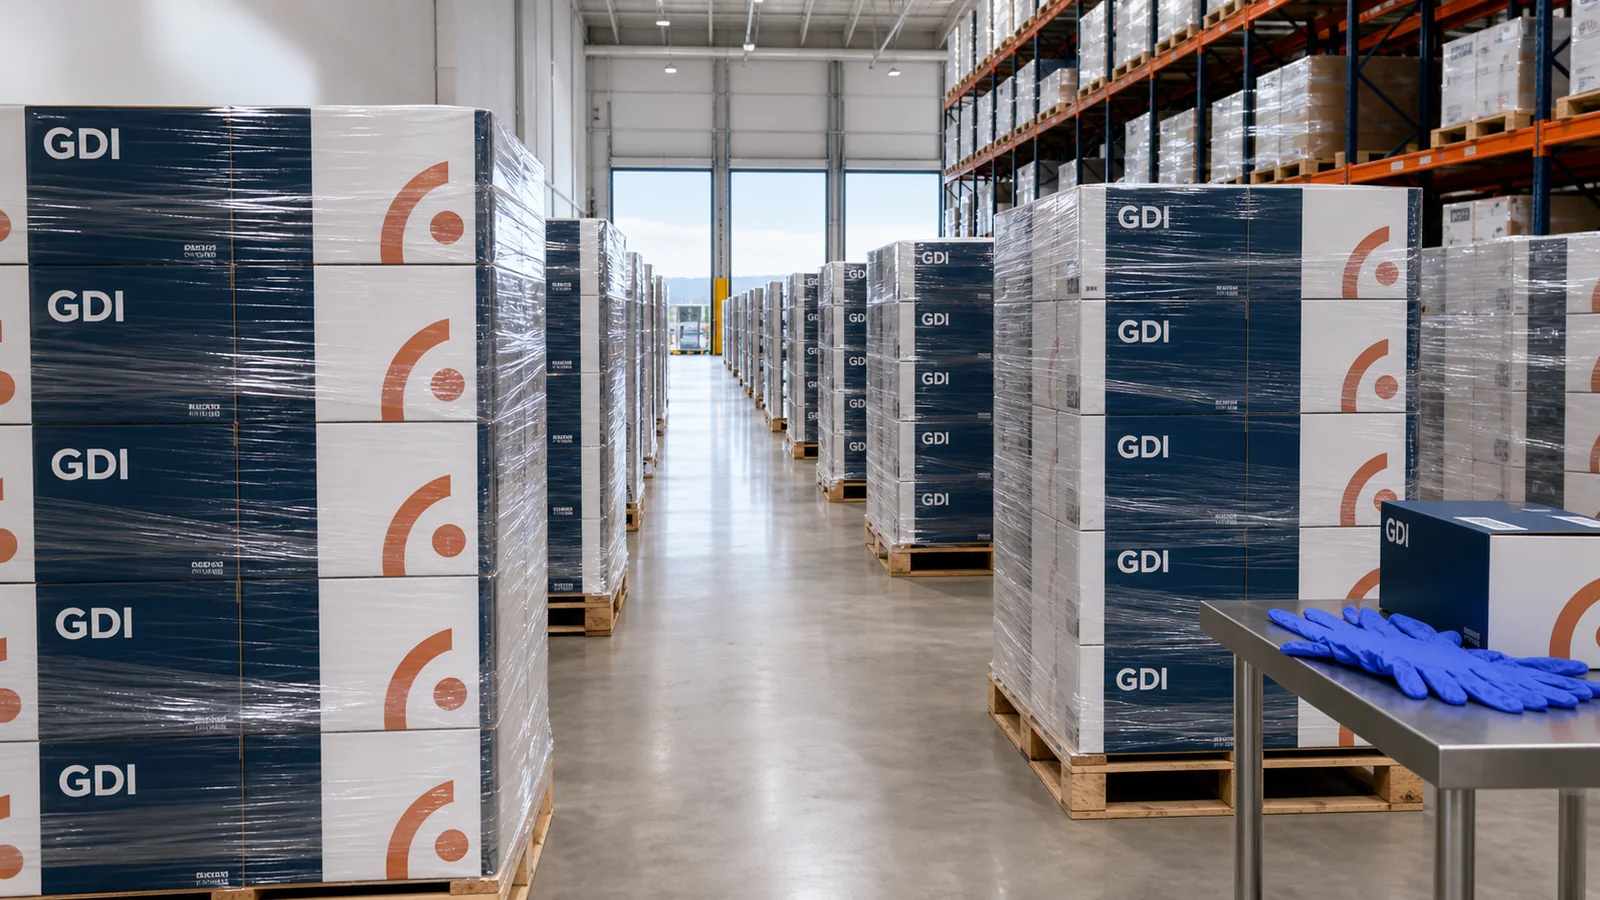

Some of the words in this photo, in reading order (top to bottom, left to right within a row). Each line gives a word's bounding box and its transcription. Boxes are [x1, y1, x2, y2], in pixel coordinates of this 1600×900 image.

[43, 127, 120, 161] GDI
[1117, 205, 1170, 229] GDI
[921, 251, 949, 265] GDI
[848, 269, 866, 279] GD
[47, 289, 124, 323] GDI
[848, 313, 866, 323] GD
[921, 312, 949, 326] GDI
[1117, 320, 1170, 343] GDI
[848, 356, 866, 366] GD
[921, 371, 949, 386] GDI
[848, 398, 866, 409] GD
[848, 441, 866, 452] GD
[921, 431, 949, 446] GDI
[1117, 435, 1169, 458] GDI
[51, 448, 129, 481] GDI
[921, 492, 949, 507] GDI
[1385, 517, 1409, 548] GDI
[1117, 550, 1169, 573] GDI
[55, 607, 133, 640] GDI
[1116, 667, 1168, 691] GDI
[59, 764, 136, 798] GDI
